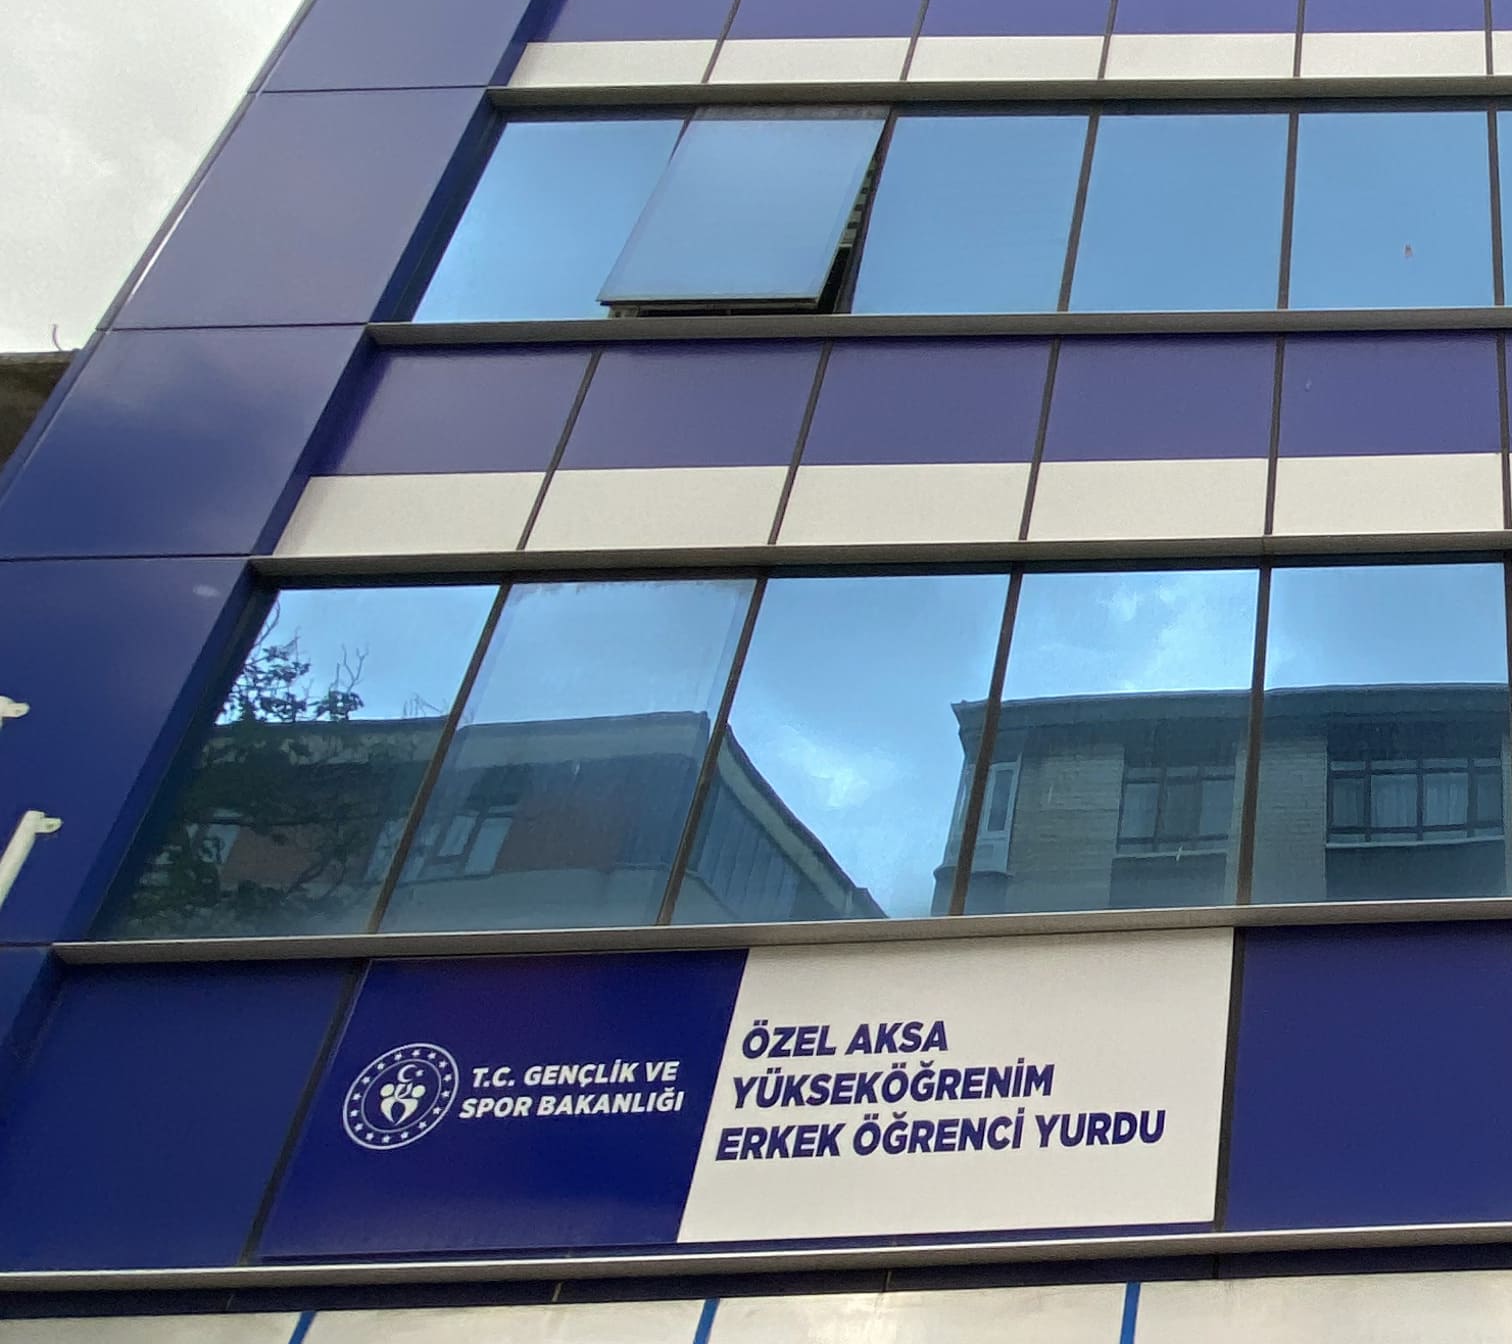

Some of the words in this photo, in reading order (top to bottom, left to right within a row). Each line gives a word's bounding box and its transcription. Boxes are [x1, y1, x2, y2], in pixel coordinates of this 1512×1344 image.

[741, 1019, 838, 1060] ÖZEL
[844, 1020, 949, 1056] AKSA
[472, 1066, 515, 1088] T.C.
[523, 1058, 640, 1089] GENÇLİK
[645, 1061, 680, 1082] VE
[732, 1057, 1056, 1110] YÜKSEKÖĞRENİM
[459, 1096, 533, 1119] SPOR
[536, 1086, 685, 1116] BAKANLIĞI
[715, 1123, 847, 1162] ERKEK
[852, 1107, 1026, 1157] ÖĞRENCİ
[1034, 1109, 1166, 1149] YURDU
